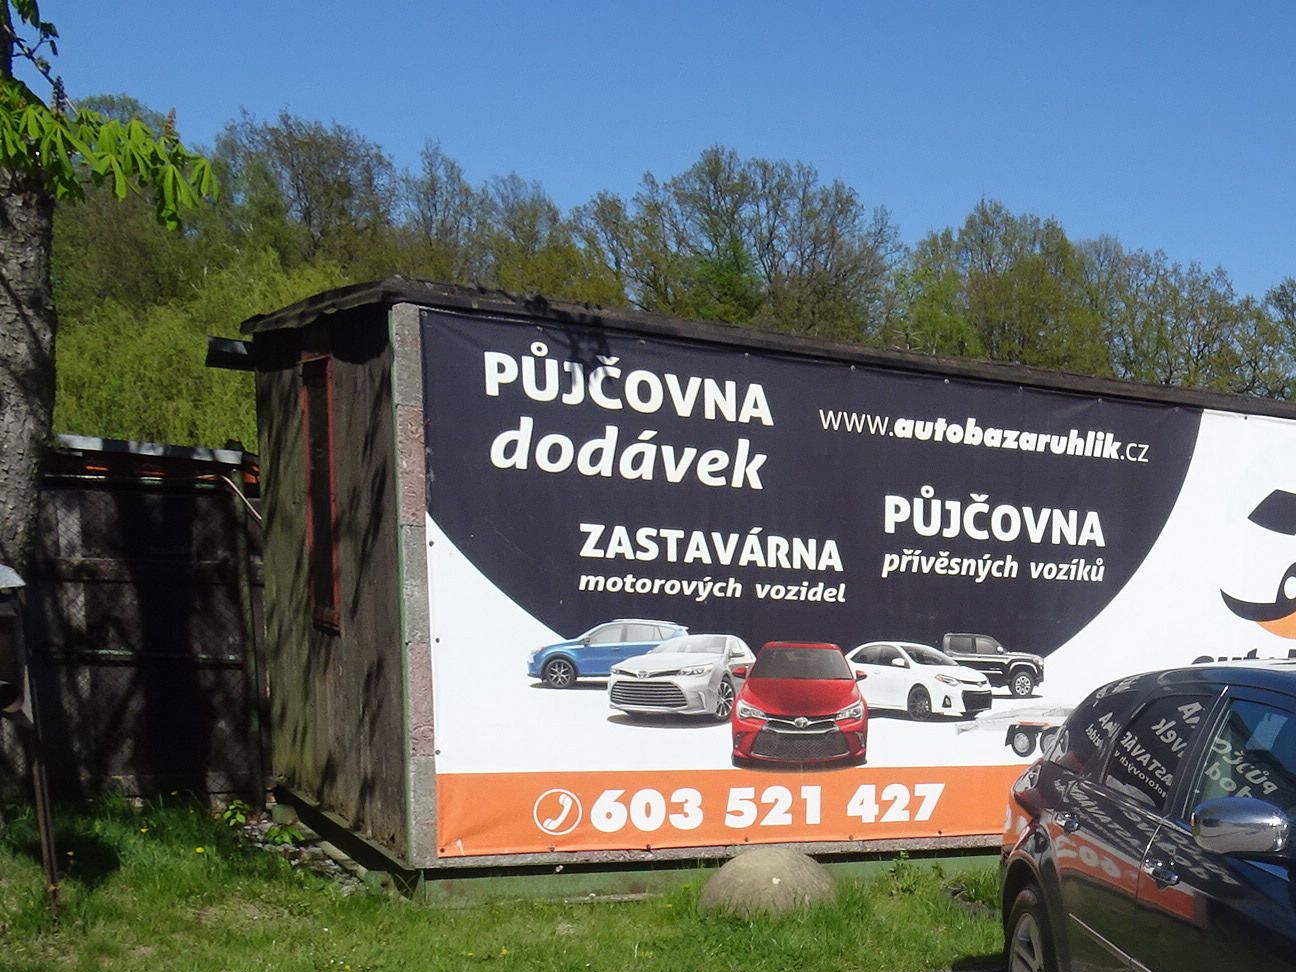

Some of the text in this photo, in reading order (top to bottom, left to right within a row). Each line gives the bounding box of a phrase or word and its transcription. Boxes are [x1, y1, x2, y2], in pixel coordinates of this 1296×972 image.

[484, 341, 774, 426] PŮJČOVNA
[490, 416, 767, 489] dodávek
[819, 409, 1150, 462] www.autobazaruhlik.cz
[884, 485, 1105, 547] PŮJČOVNA
[579, 523, 843, 572] ZASTAVÁRNA
[881, 549, 1105, 583] přívěsných vozíků
[579, 574, 846, 603] motorových vozidel
[590, 783, 946, 833] 603 521 427
